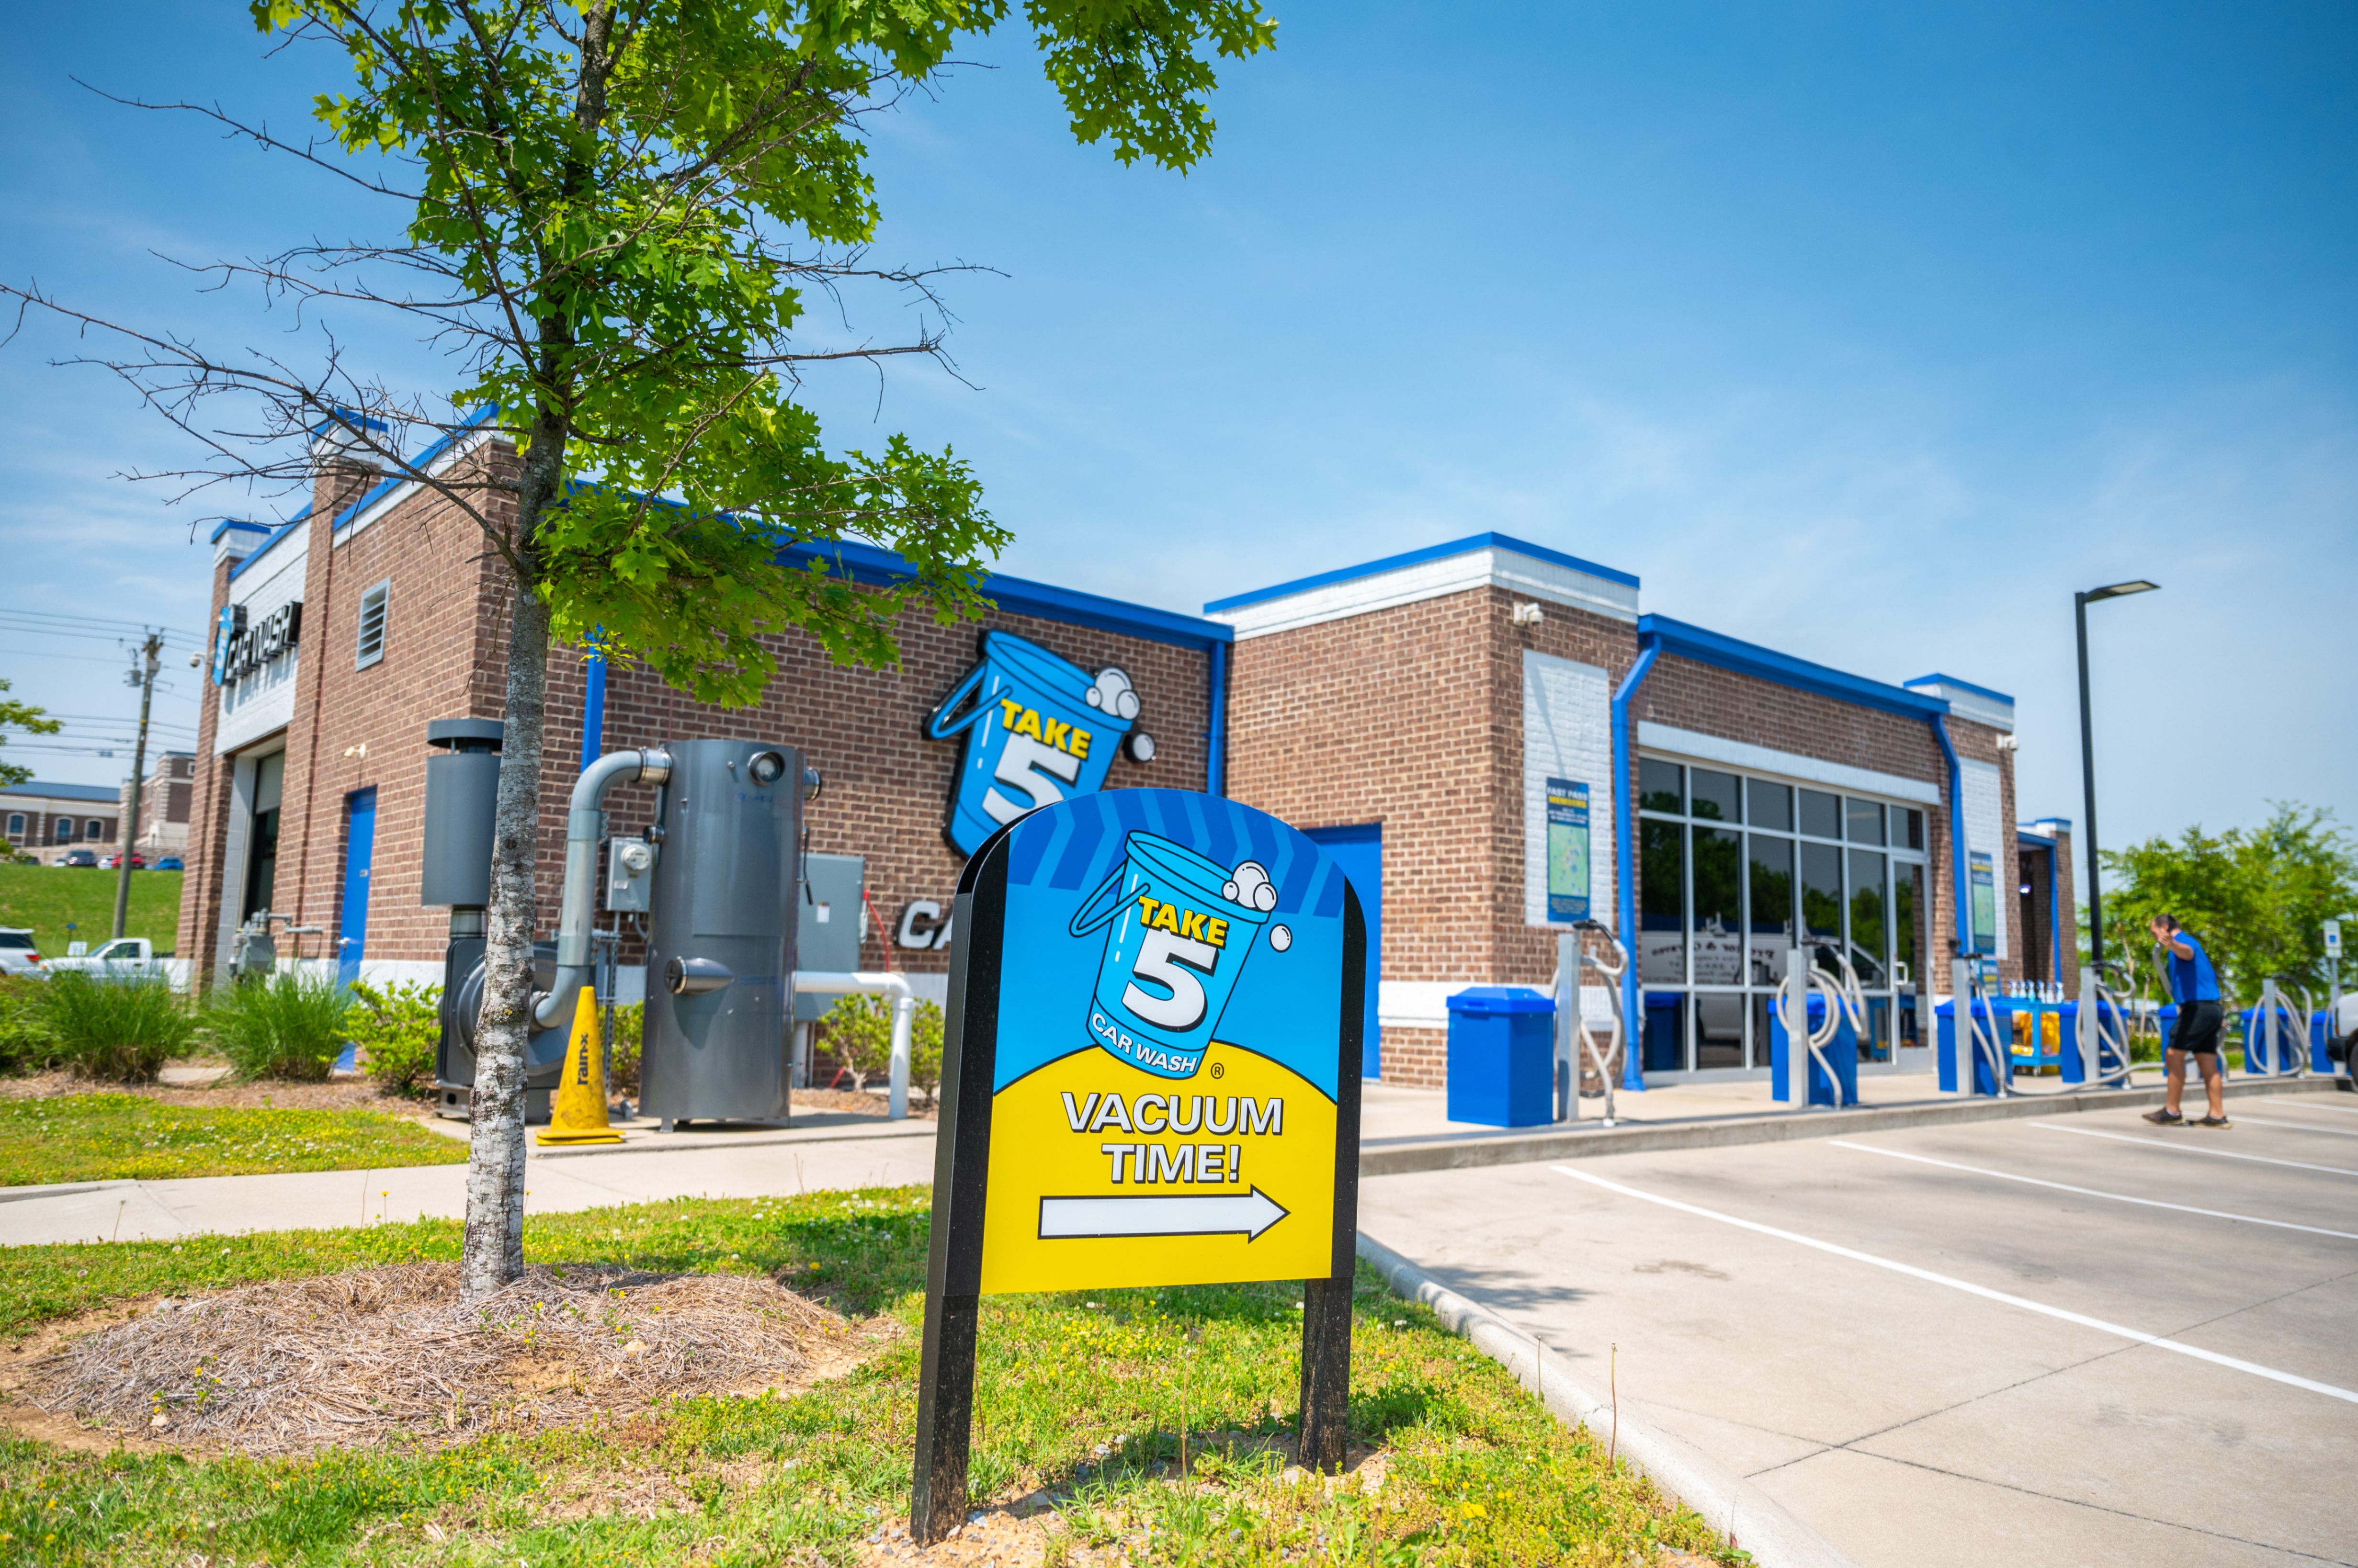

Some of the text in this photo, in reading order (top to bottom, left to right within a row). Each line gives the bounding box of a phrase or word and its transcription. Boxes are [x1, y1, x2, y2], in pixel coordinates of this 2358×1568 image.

[226, 601, 299, 679] CAR WASH
[1000, 698, 1092, 762] TAKE
[982, 733, 1081, 826] 5
[1567, 790, 1587, 801] PASS
[1138, 895, 1229, 950] TAKE
[1122, 927, 1219, 1033] 5
[1092, 1013, 1198, 1073] CAR WASH
[1061, 1092, 1284, 1135] VACUUM
[1101, 1143, 1241, 1184] TIME!
